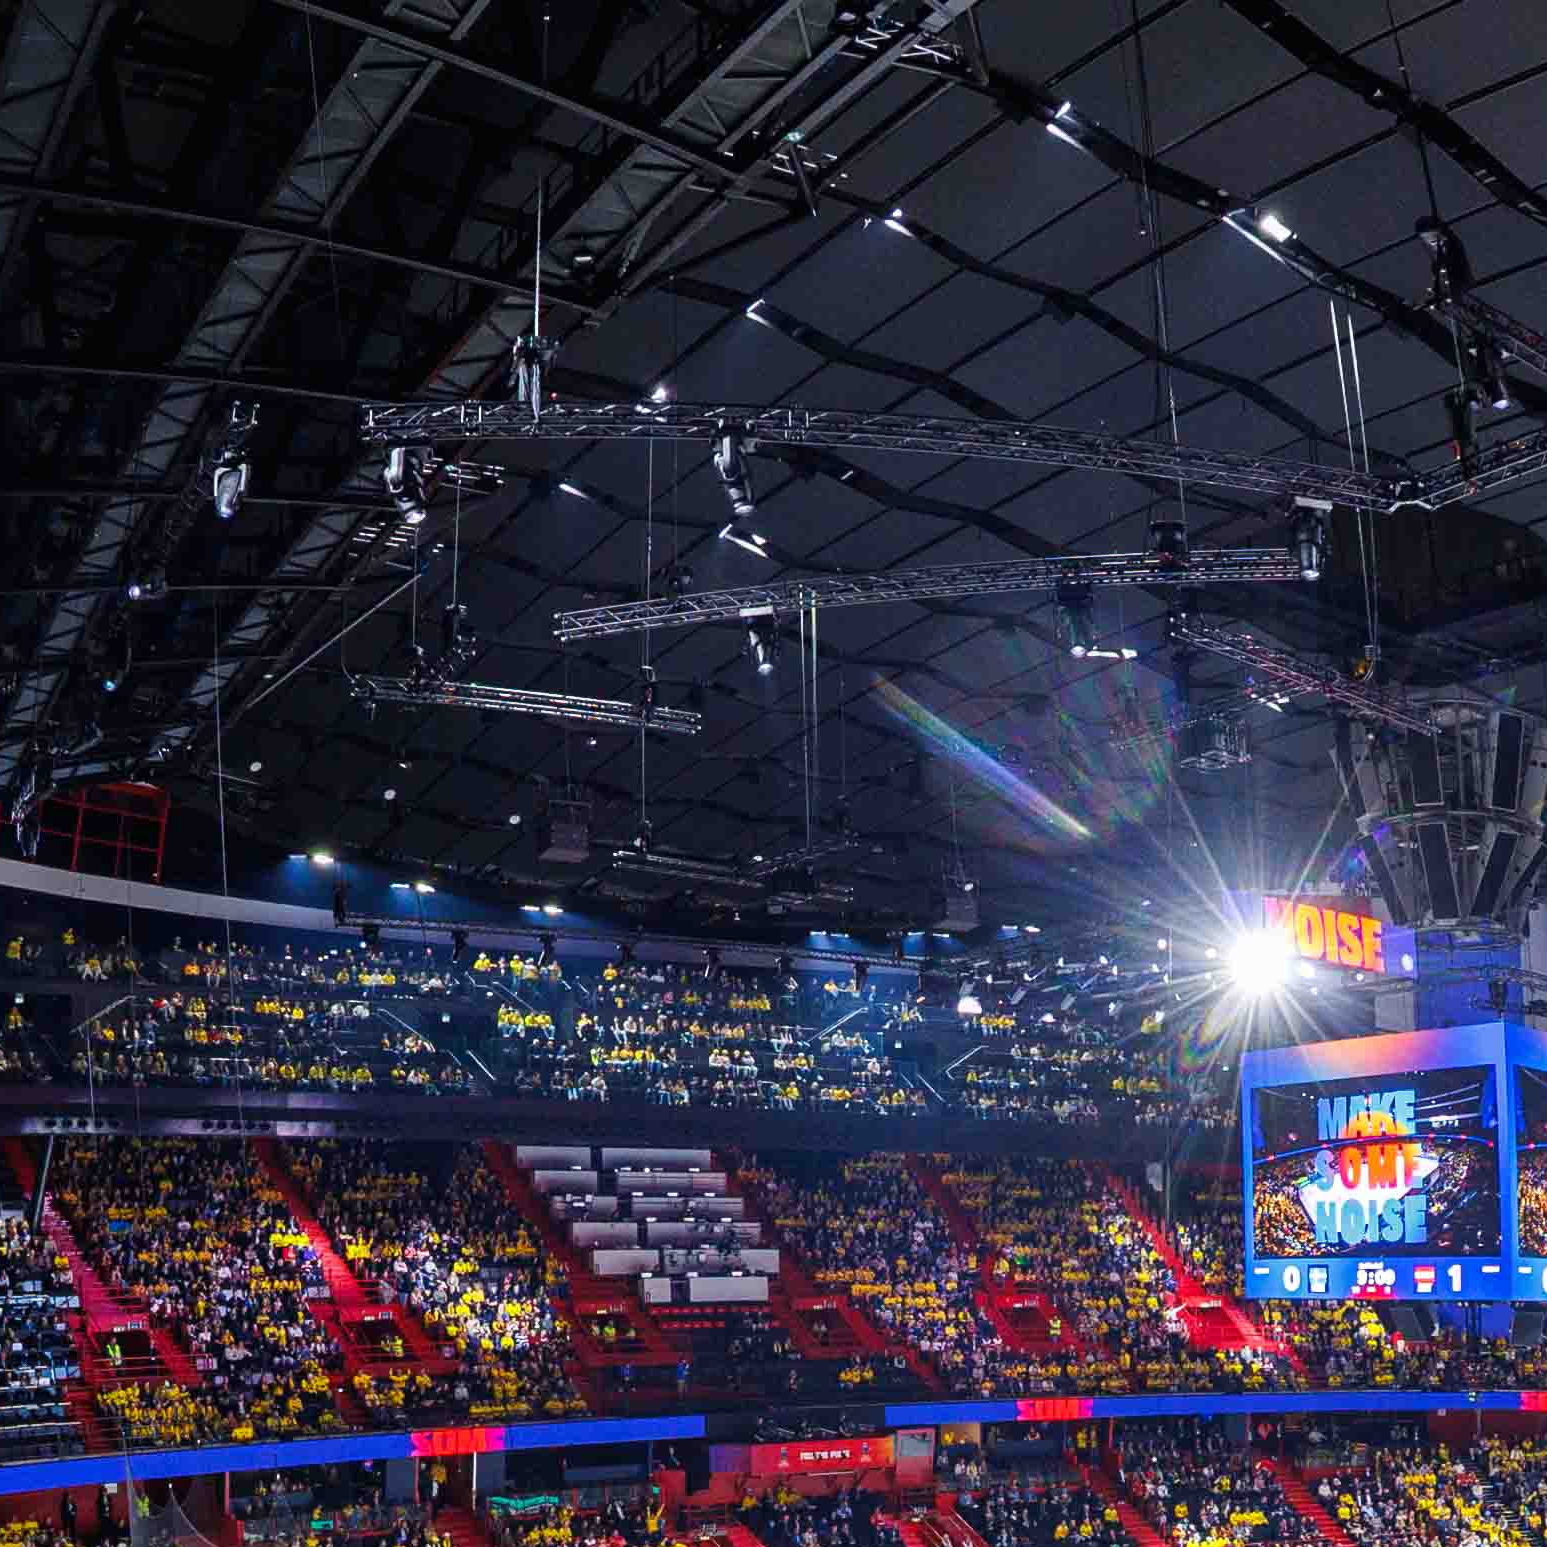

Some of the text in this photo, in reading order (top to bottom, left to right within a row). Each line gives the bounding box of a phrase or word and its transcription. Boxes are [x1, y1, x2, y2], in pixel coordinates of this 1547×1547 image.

[1317, 1089, 1416, 1142] MAKE
[1315, 1143, 1423, 1192] SOME
[1315, 1194, 1427, 1244] NOISE
[1282, 1265, 1302, 1292] 0
[1447, 1264, 1462, 1292] 1
